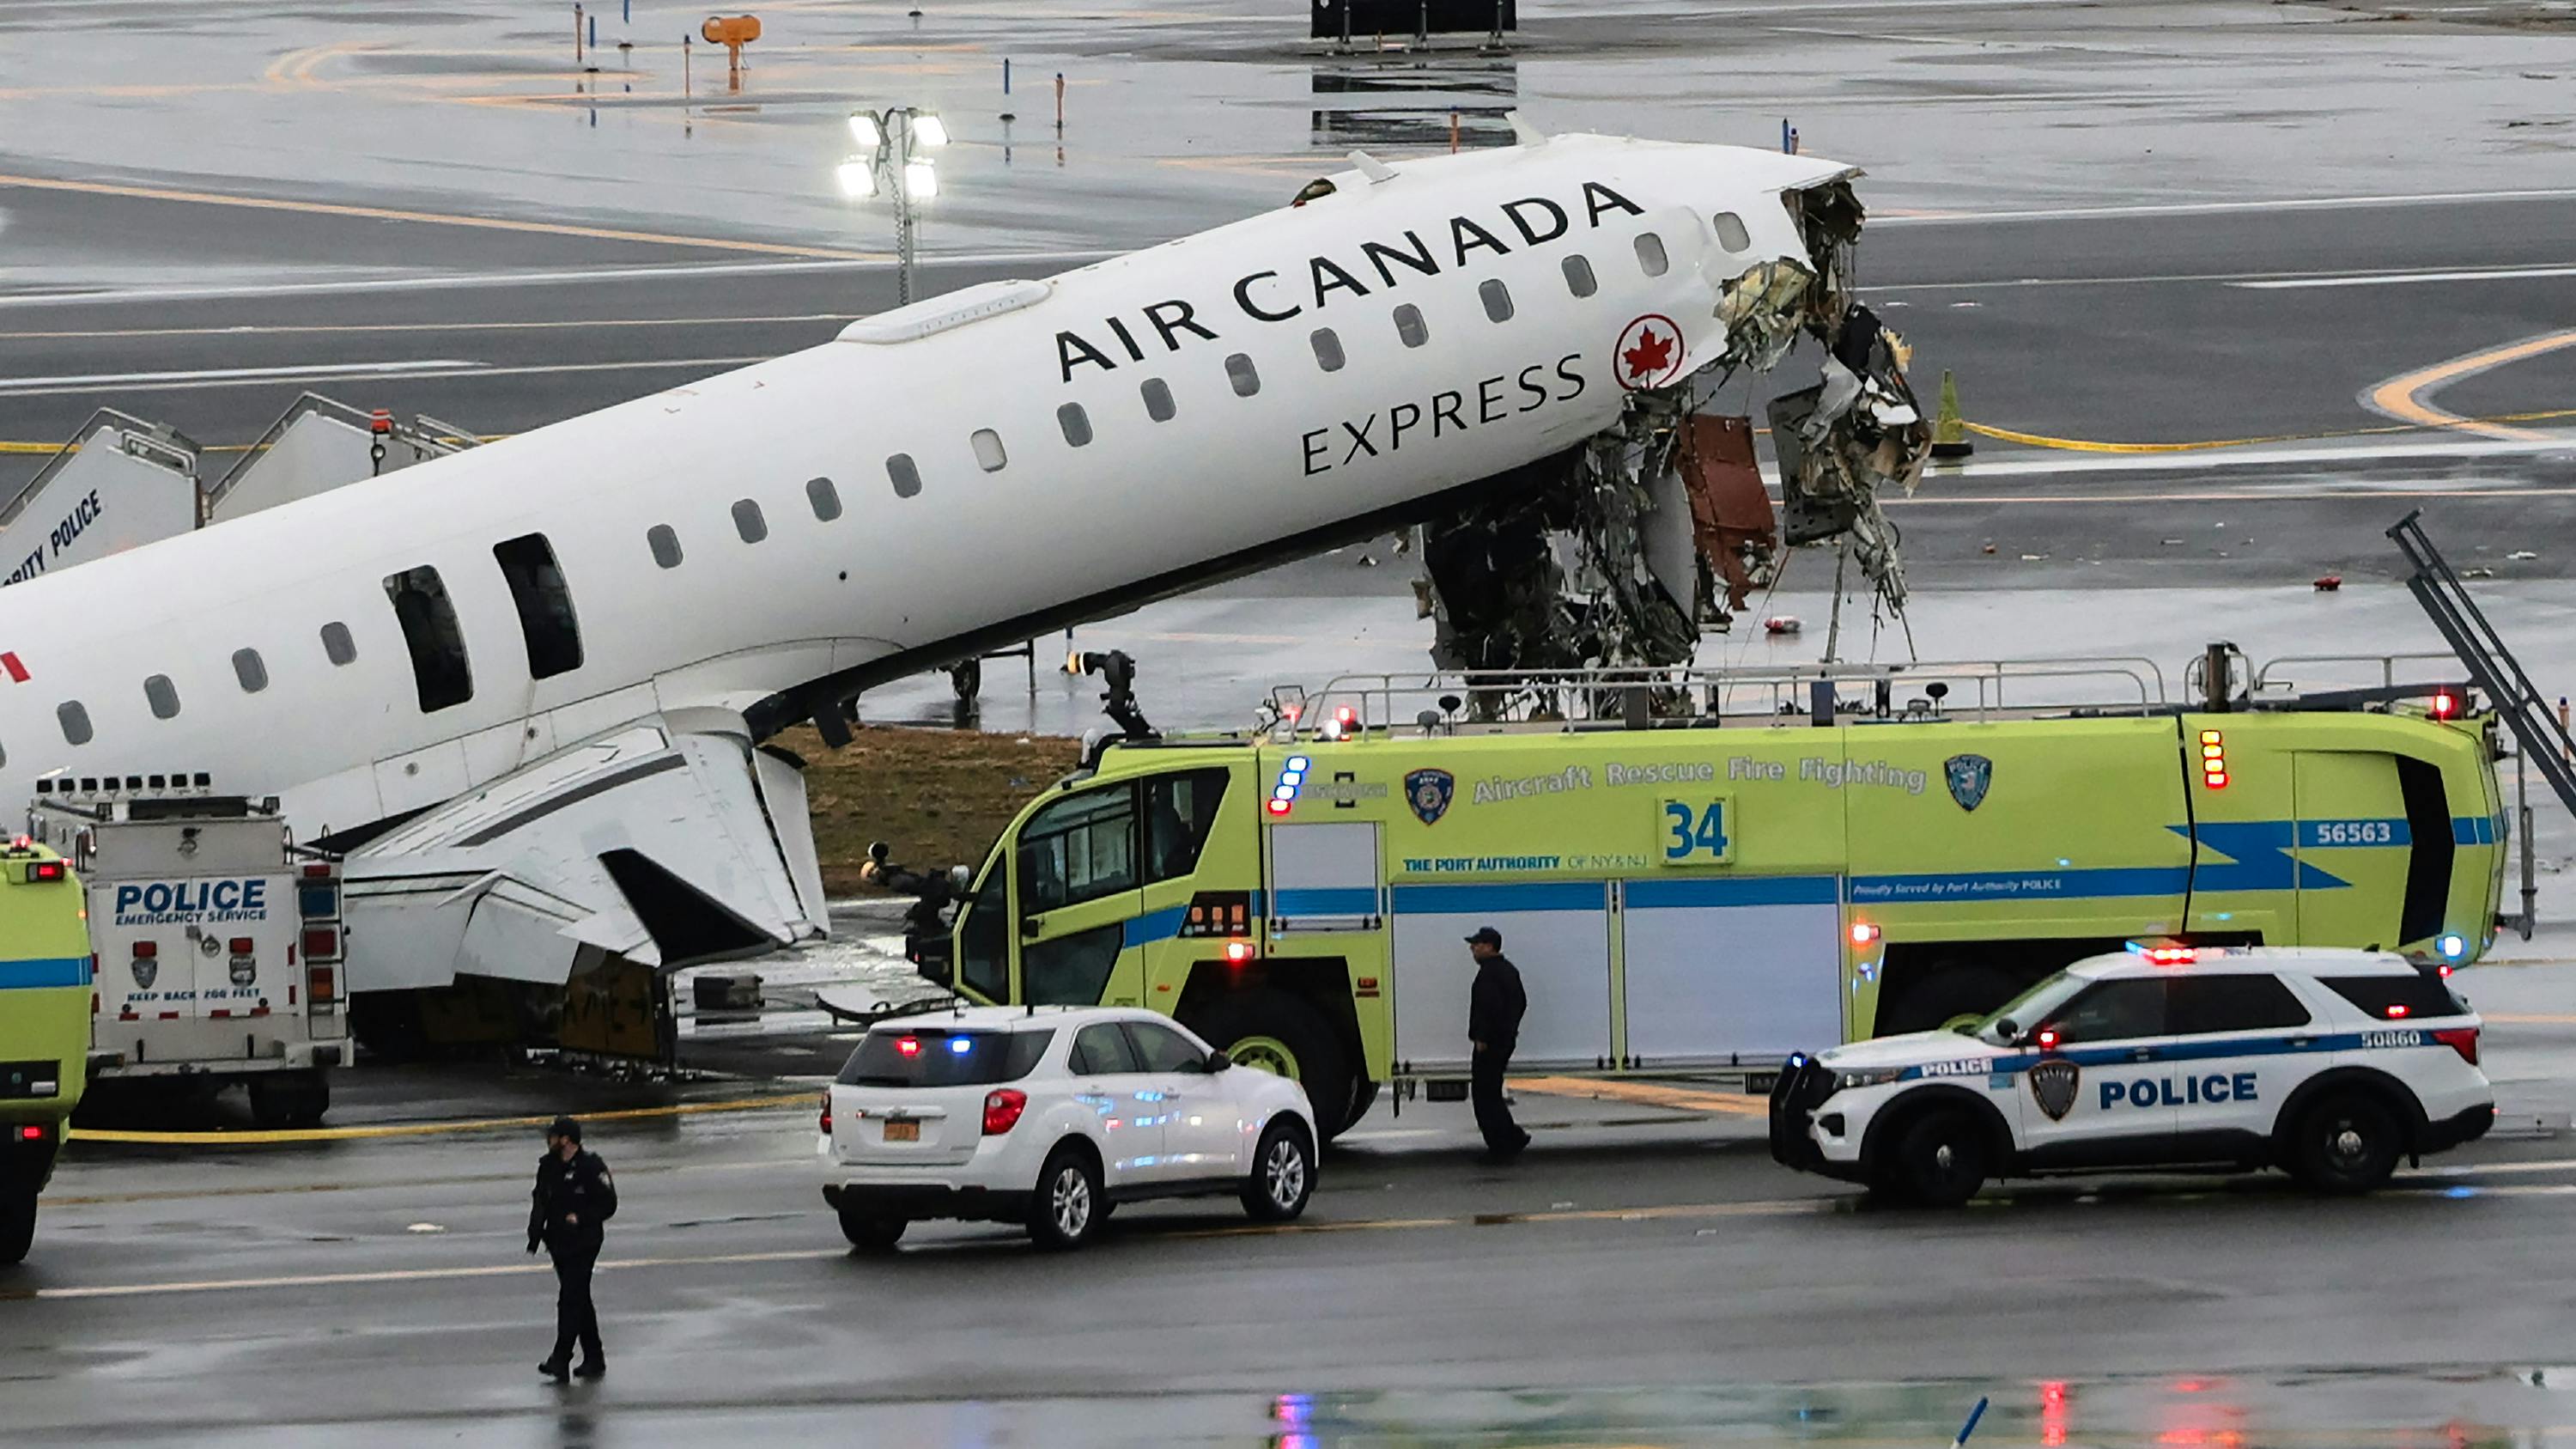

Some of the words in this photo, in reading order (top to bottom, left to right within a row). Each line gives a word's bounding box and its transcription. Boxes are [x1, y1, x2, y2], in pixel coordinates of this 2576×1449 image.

[1055, 300, 1219, 383] AIR
[1233, 182, 1646, 322] CANADA
[1302, 354, 1586, 477] EXPRESS
[51, 489, 101, 557] POLICE
[1472, 766, 1592, 805] Aircraft
[1606, 762, 1714, 786] Rescue
[1728, 756, 1784, 780] Fire
[1800, 757, 1926, 794] Fighting
[1665, 802, 1728, 859] 34
[2317, 822, 2391, 844] 56563
[1403, 858, 1431, 871] THE
[1436, 857, 1477, 871] PORT
[1477, 855, 1560, 871] AUTHORITY
[116, 880, 266, 914] POLICE
[2021, 879, 2062, 890] POLICE
[115, 912, 203, 926] EMERGENCY
[208, 910, 267, 922] SERVICE
[128, 991, 158, 1002] KEEP
[164, 990, 196, 1001] BACK
[233, 988, 261, 998] FEET
[2360, 1030, 2421, 1048] 50860
[1920, 1056, 1994, 1076] POLICE
[2099, 1072, 2258, 1110] POLICE
